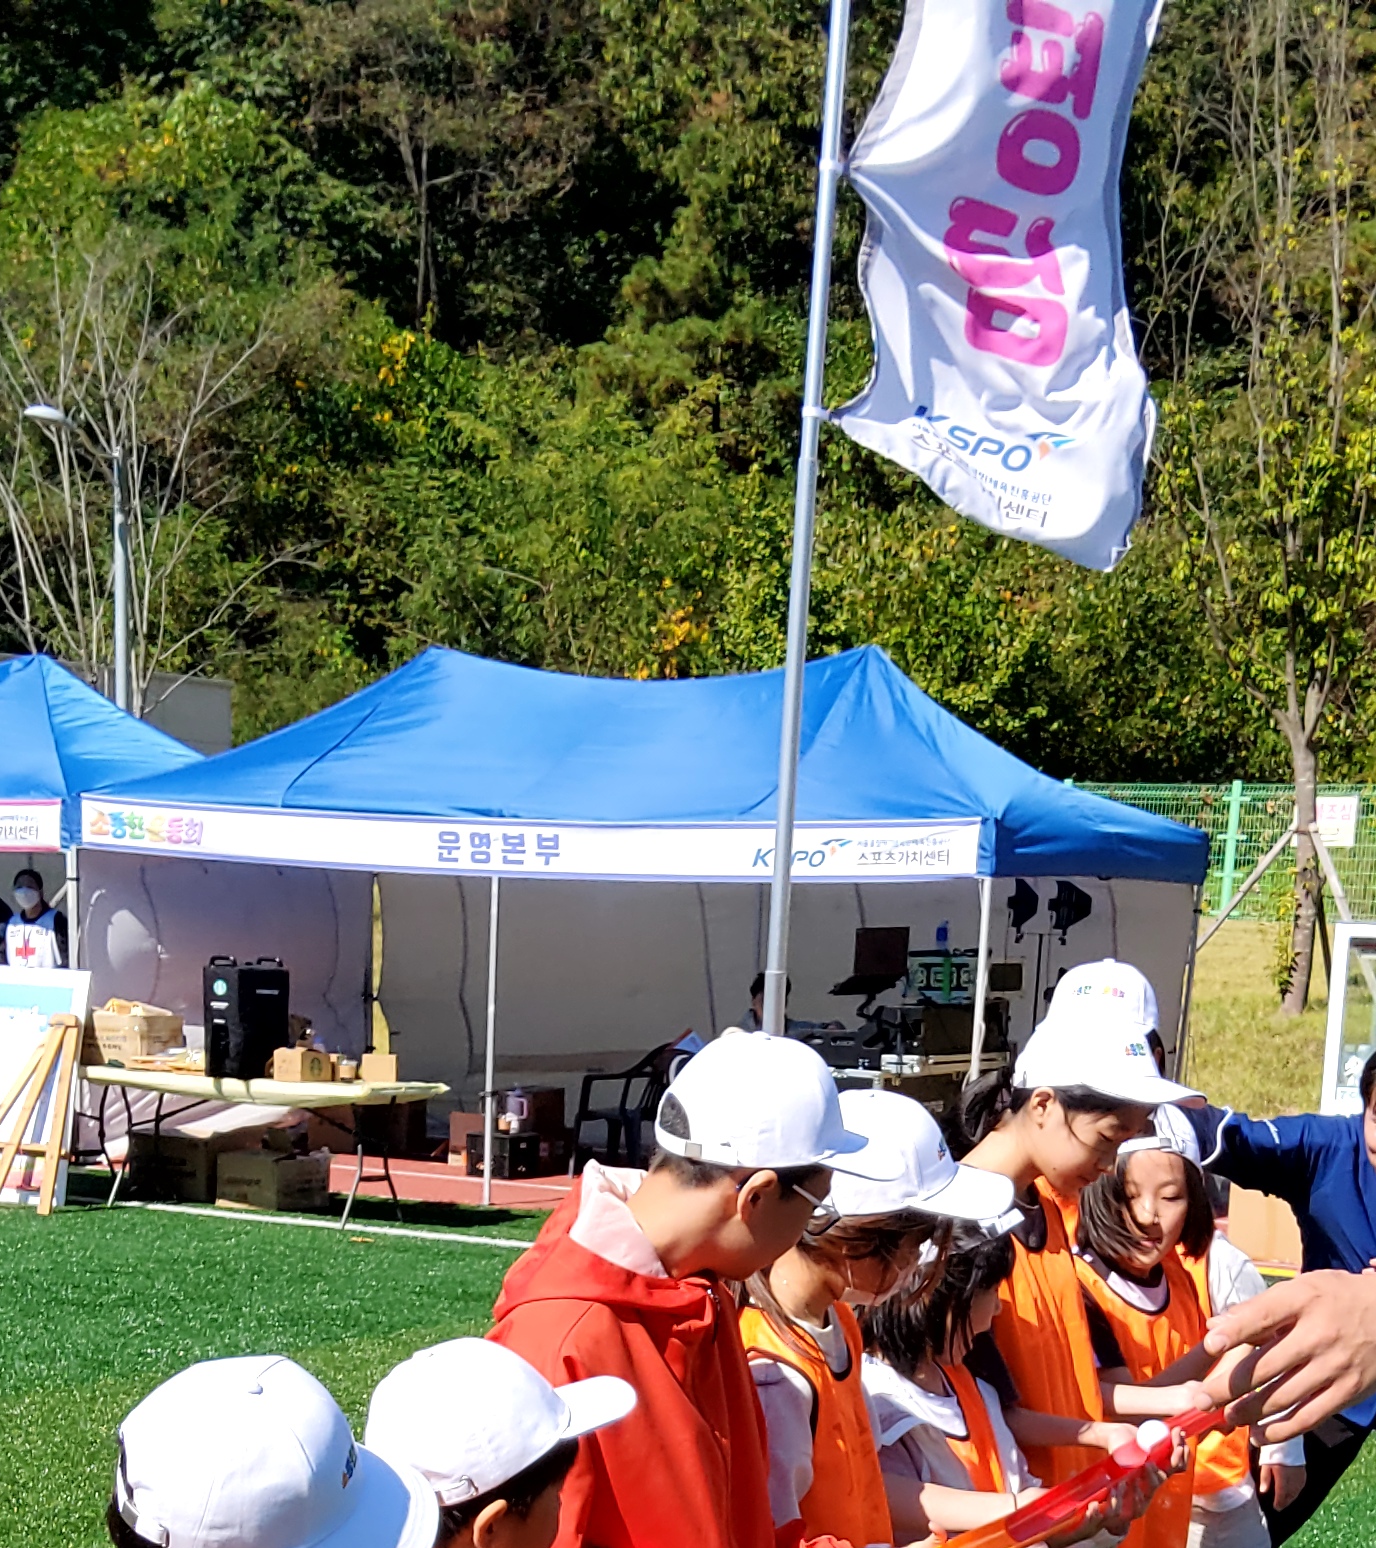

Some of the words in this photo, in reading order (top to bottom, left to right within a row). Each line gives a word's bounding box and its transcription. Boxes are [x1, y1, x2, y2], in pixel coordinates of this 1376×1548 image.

[437, 830, 561, 866] 운영본부
[752, 847, 826, 868] KPO
[856, 849, 950, 867] 스포츠가치센터
